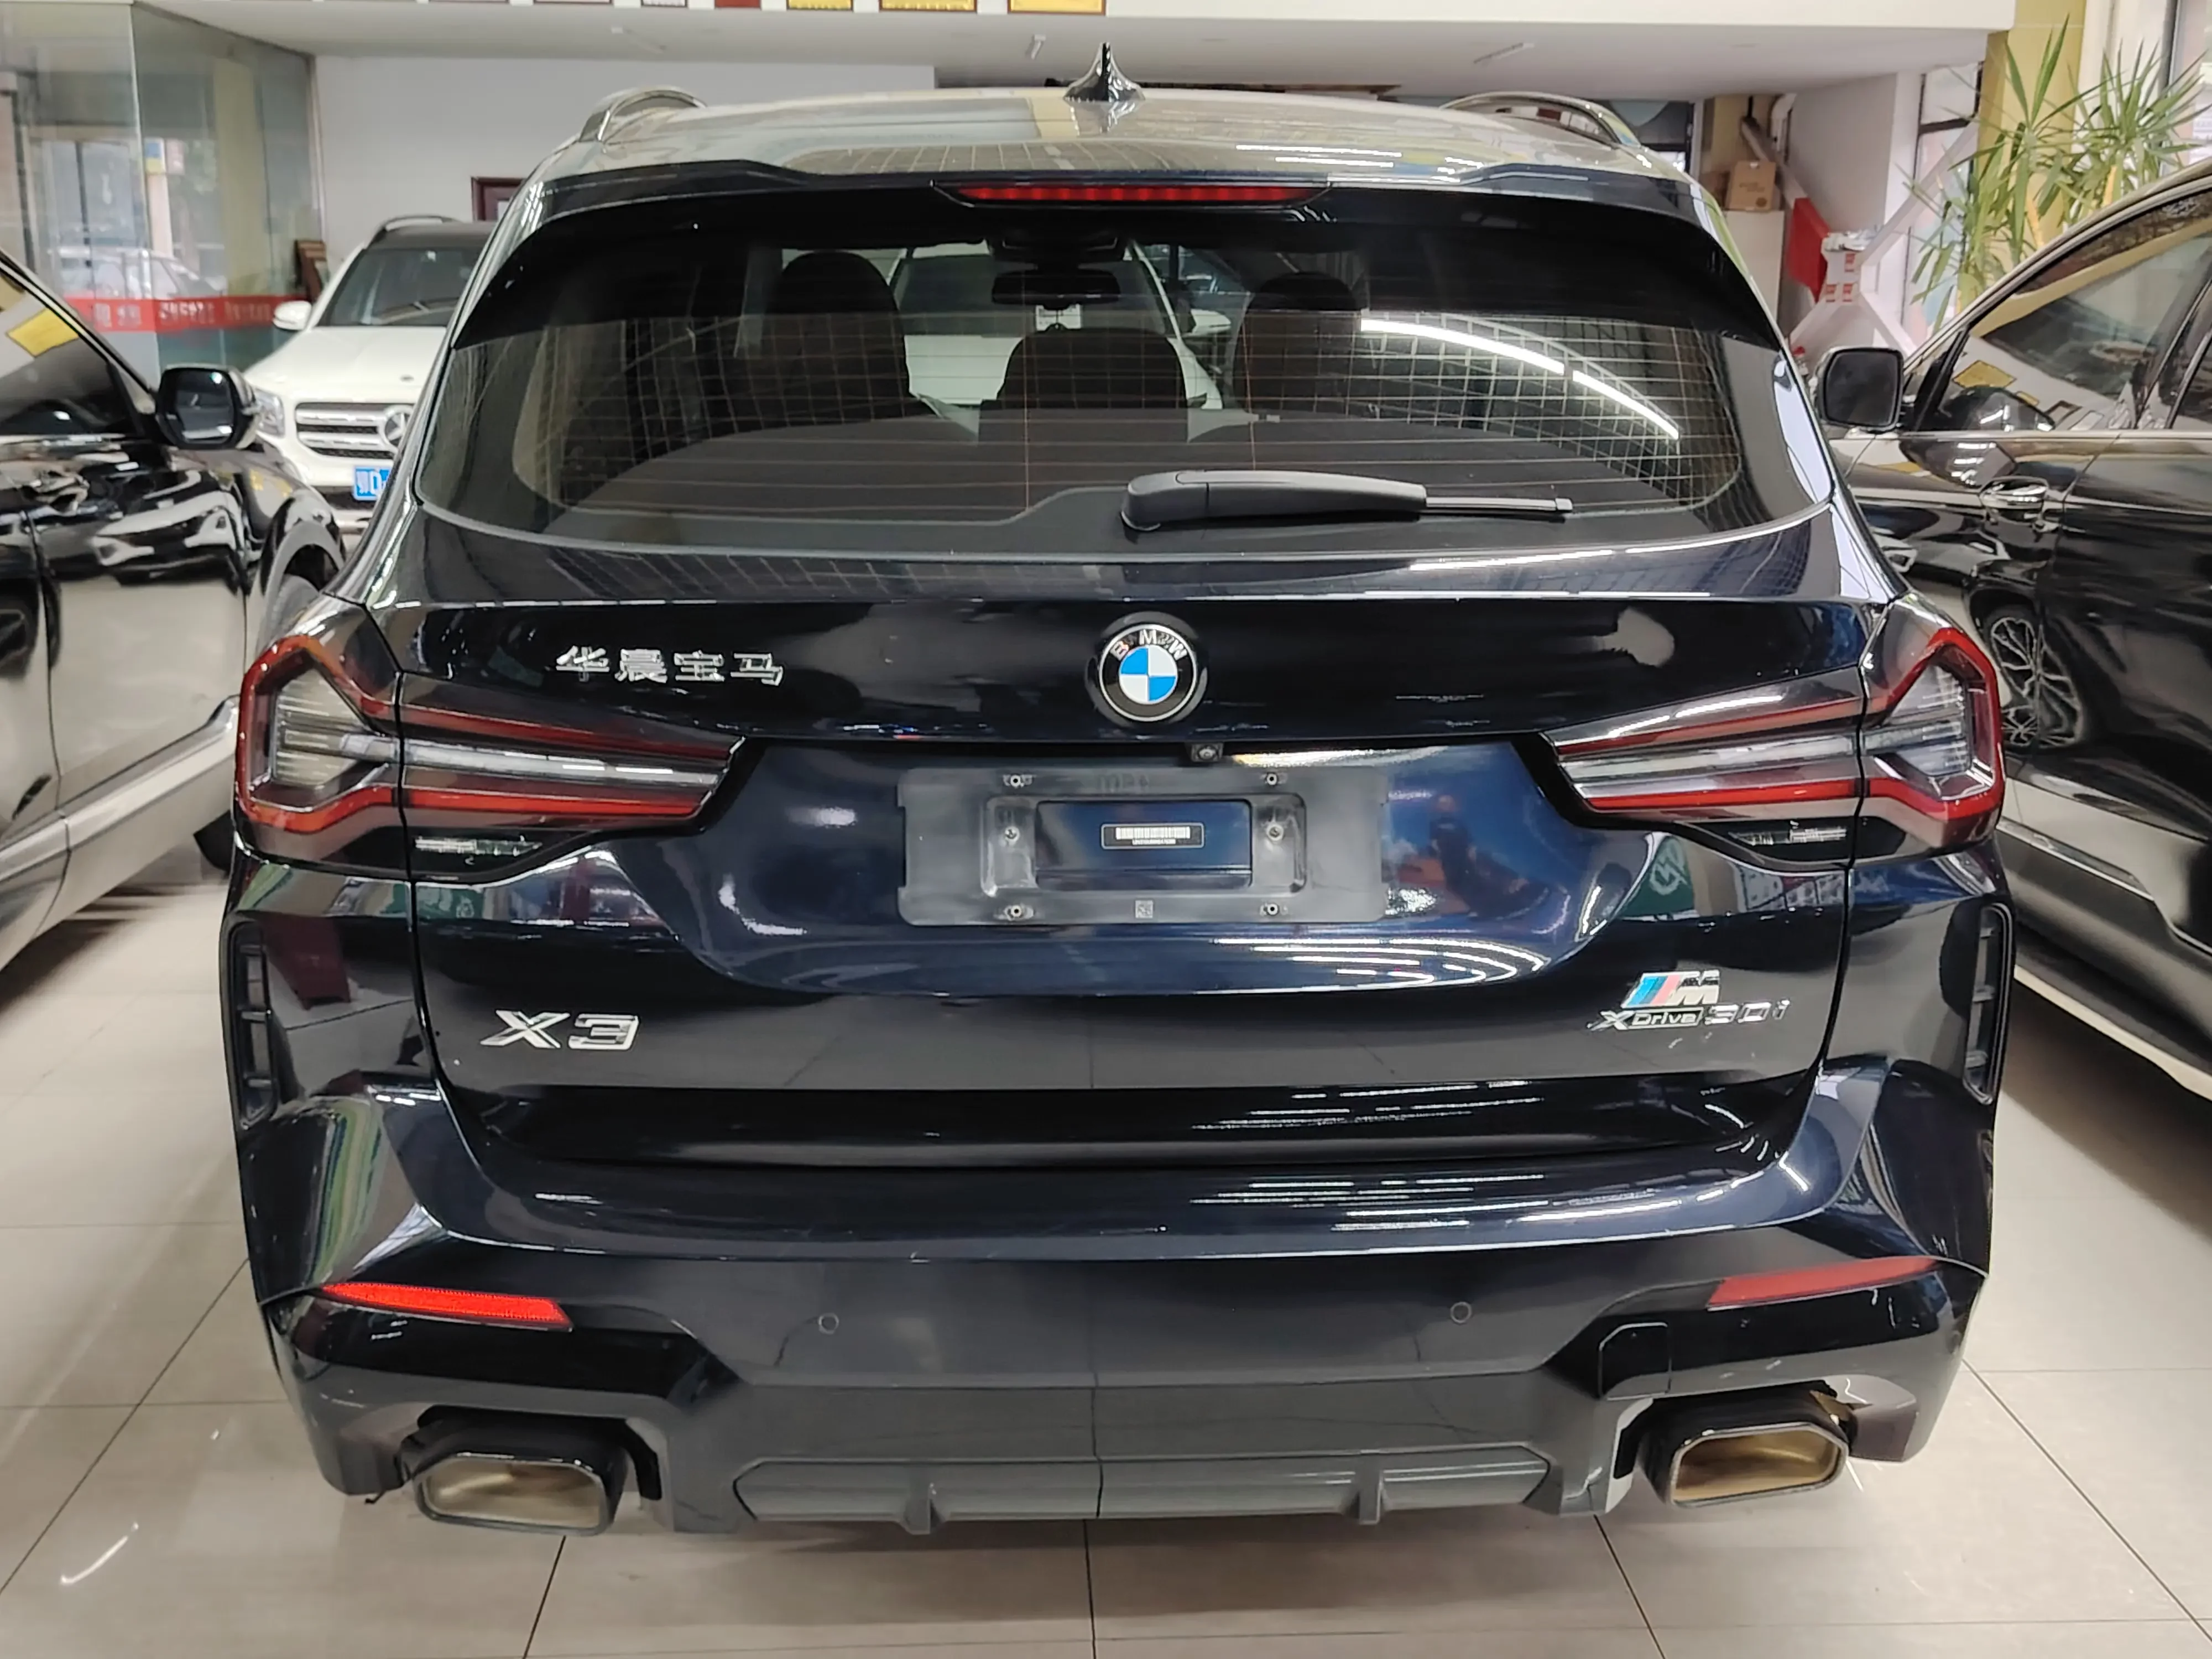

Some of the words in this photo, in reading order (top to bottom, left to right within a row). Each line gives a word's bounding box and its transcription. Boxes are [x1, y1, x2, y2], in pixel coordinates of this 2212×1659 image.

[555, 645, 784, 686] 华晨宝马
[1109, 629, 1188, 661] BMW
[479, 1009, 639, 1050] X3
